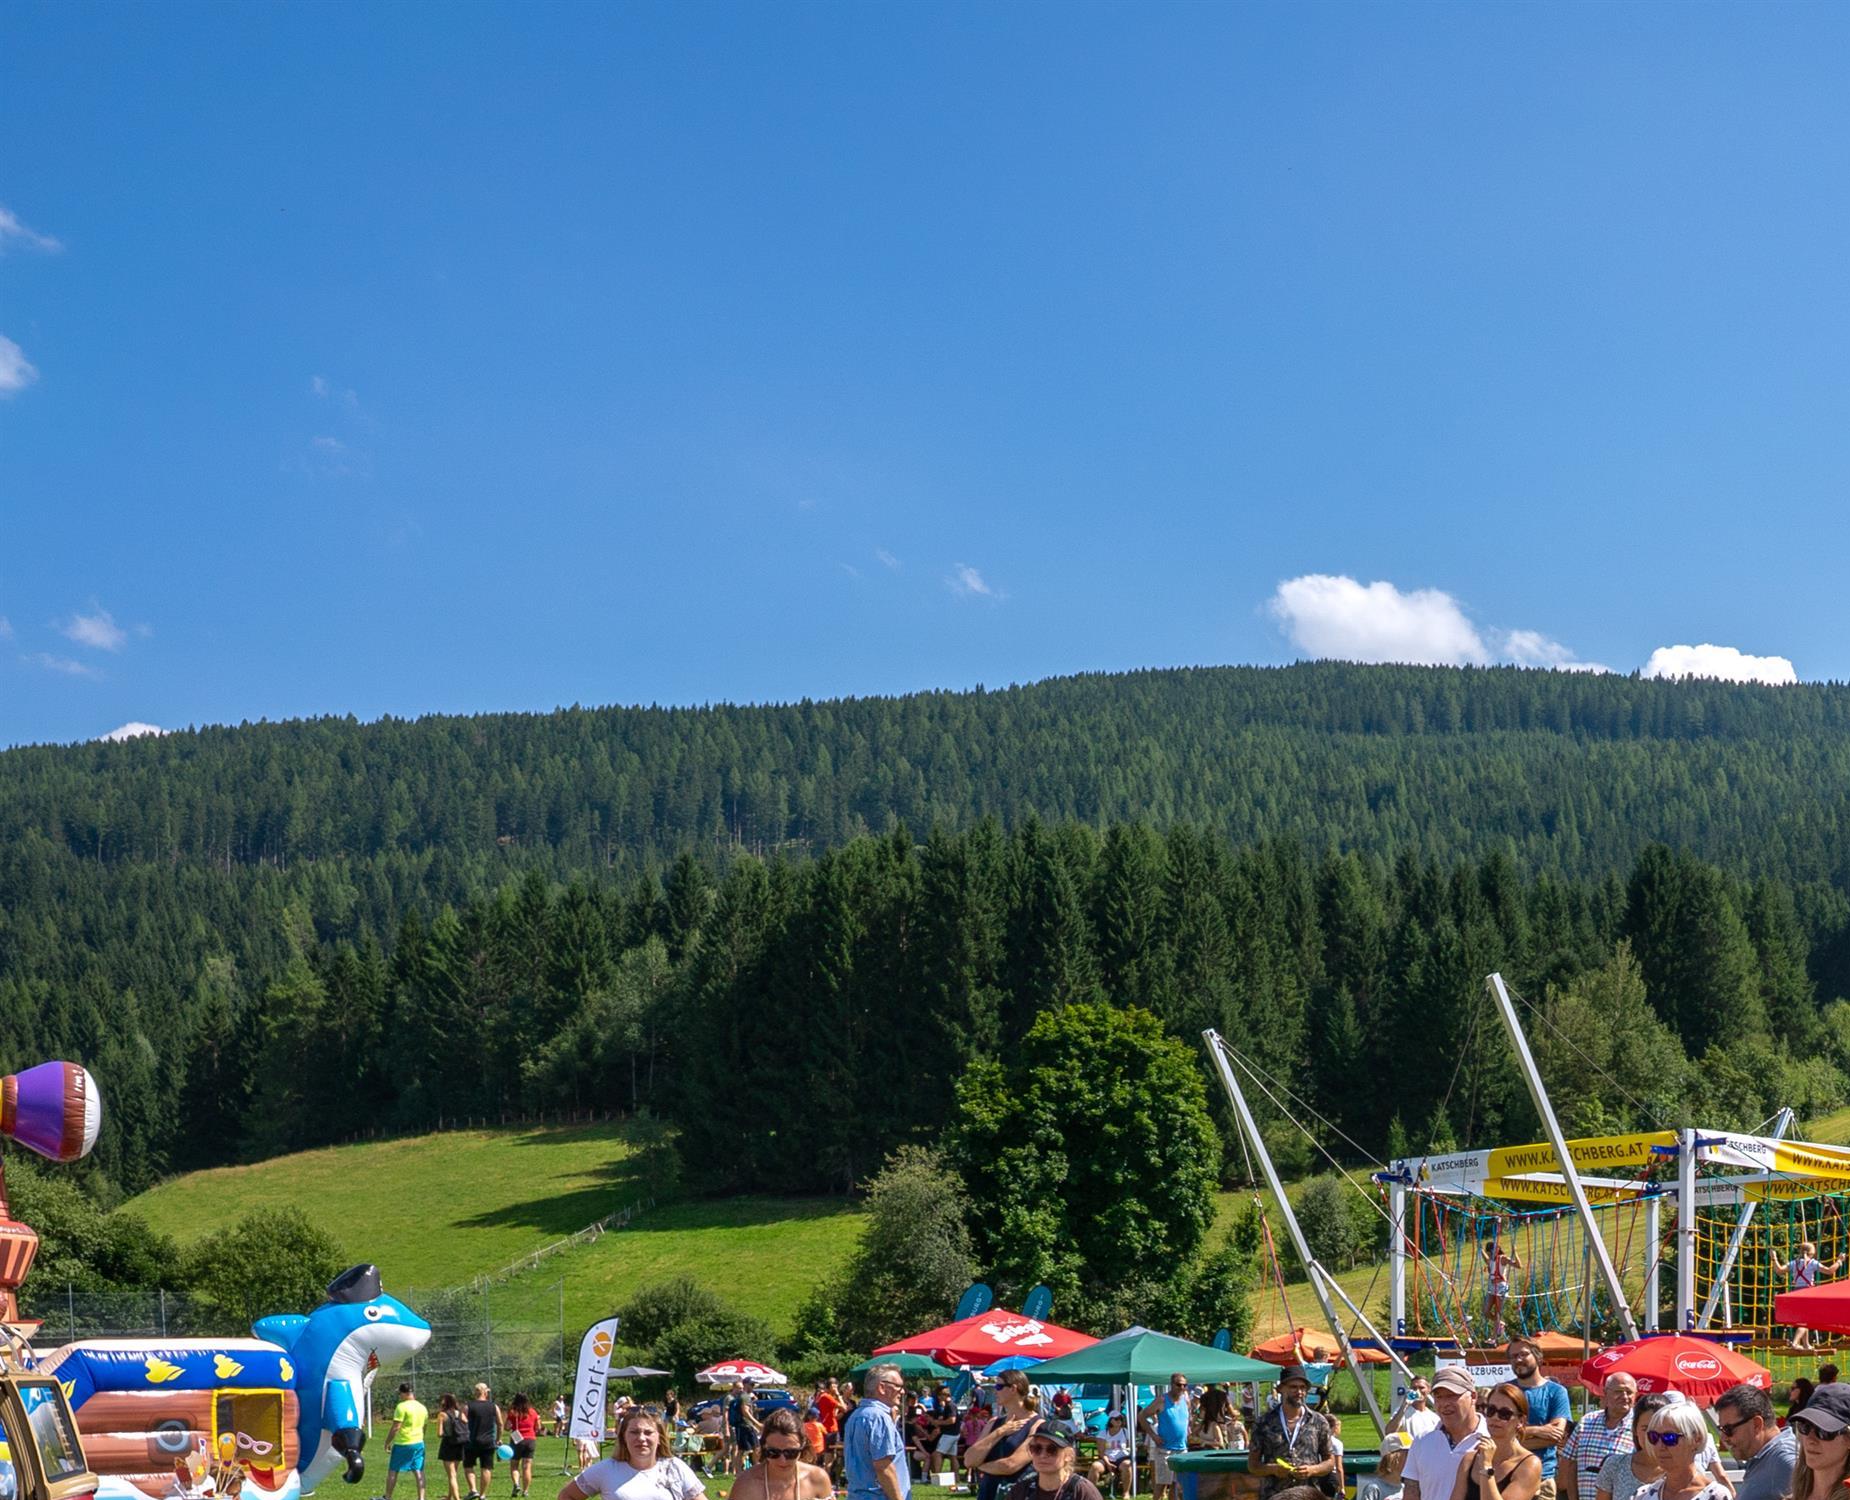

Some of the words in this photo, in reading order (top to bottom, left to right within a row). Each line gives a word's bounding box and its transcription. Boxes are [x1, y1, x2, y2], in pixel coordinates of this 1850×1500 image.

[1504, 1142, 1644, 1169] WWW.KASCHBERG.AT
[1431, 1157, 1479, 1171] KATSCHBERG
[1679, 1359, 1717, 1371] Coca-Cola
